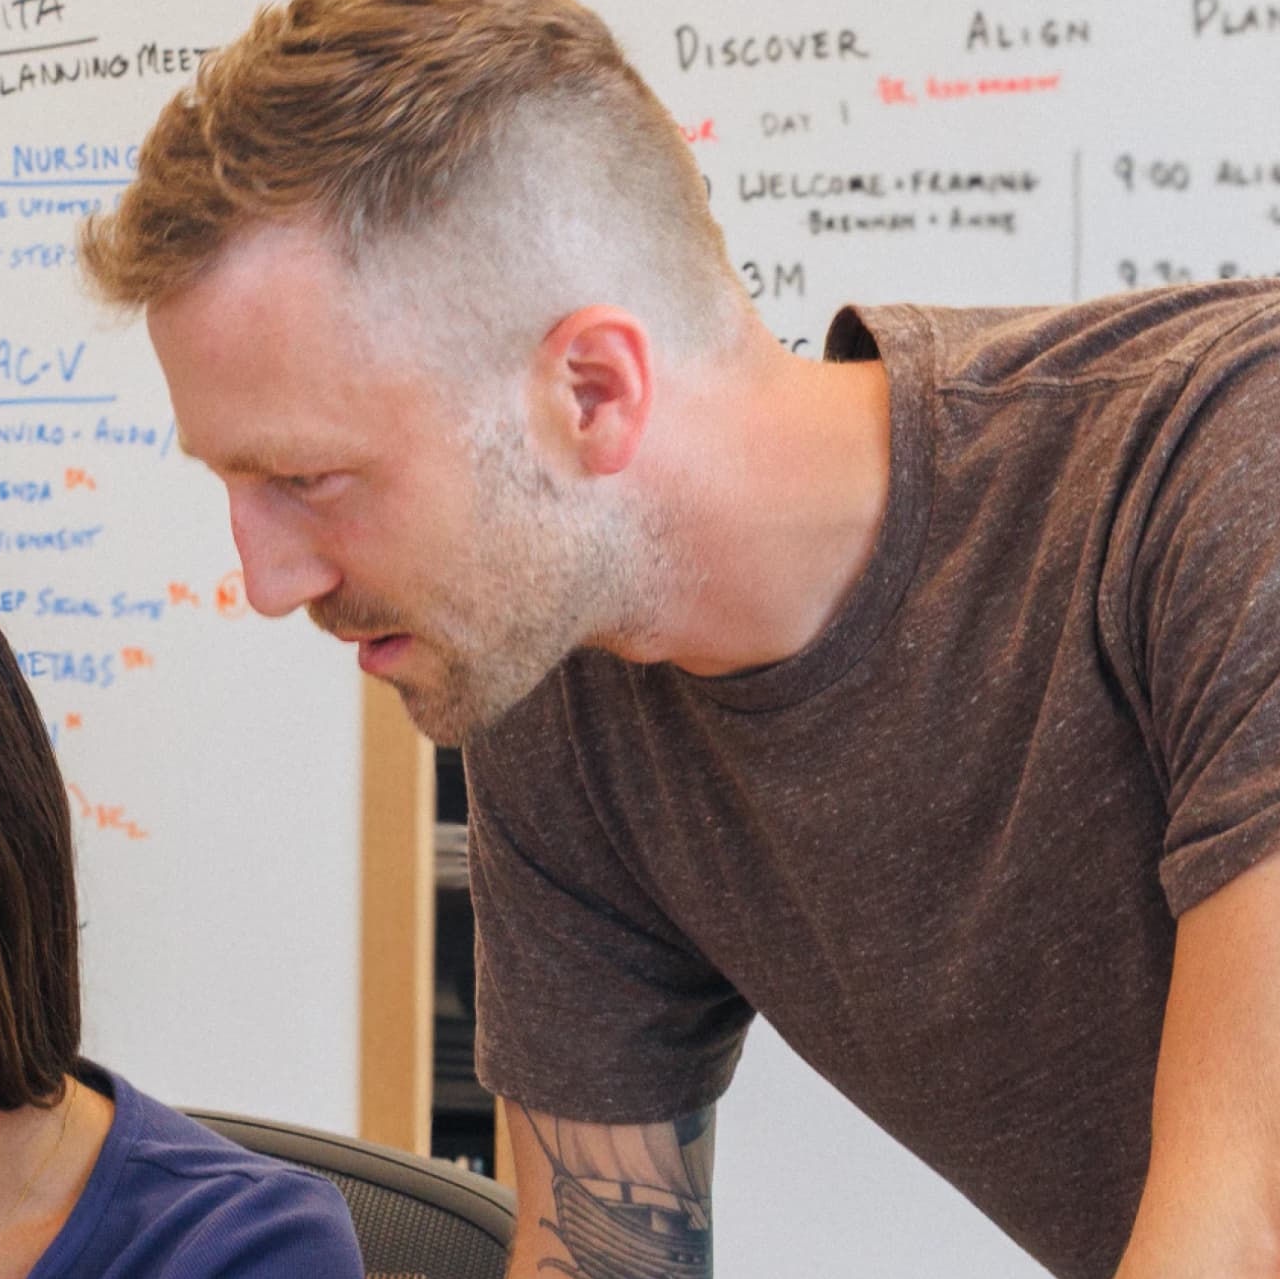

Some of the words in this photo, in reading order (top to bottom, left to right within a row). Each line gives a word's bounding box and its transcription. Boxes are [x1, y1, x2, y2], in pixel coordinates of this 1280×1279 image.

[674, 24, 870, 72] DISCOVER
[966, 10, 1091, 51] ALIGN
[760, 111, 813, 140] DAY
[12, 140, 141, 177] NURSING
[738, 172, 888, 202] WELCOME
